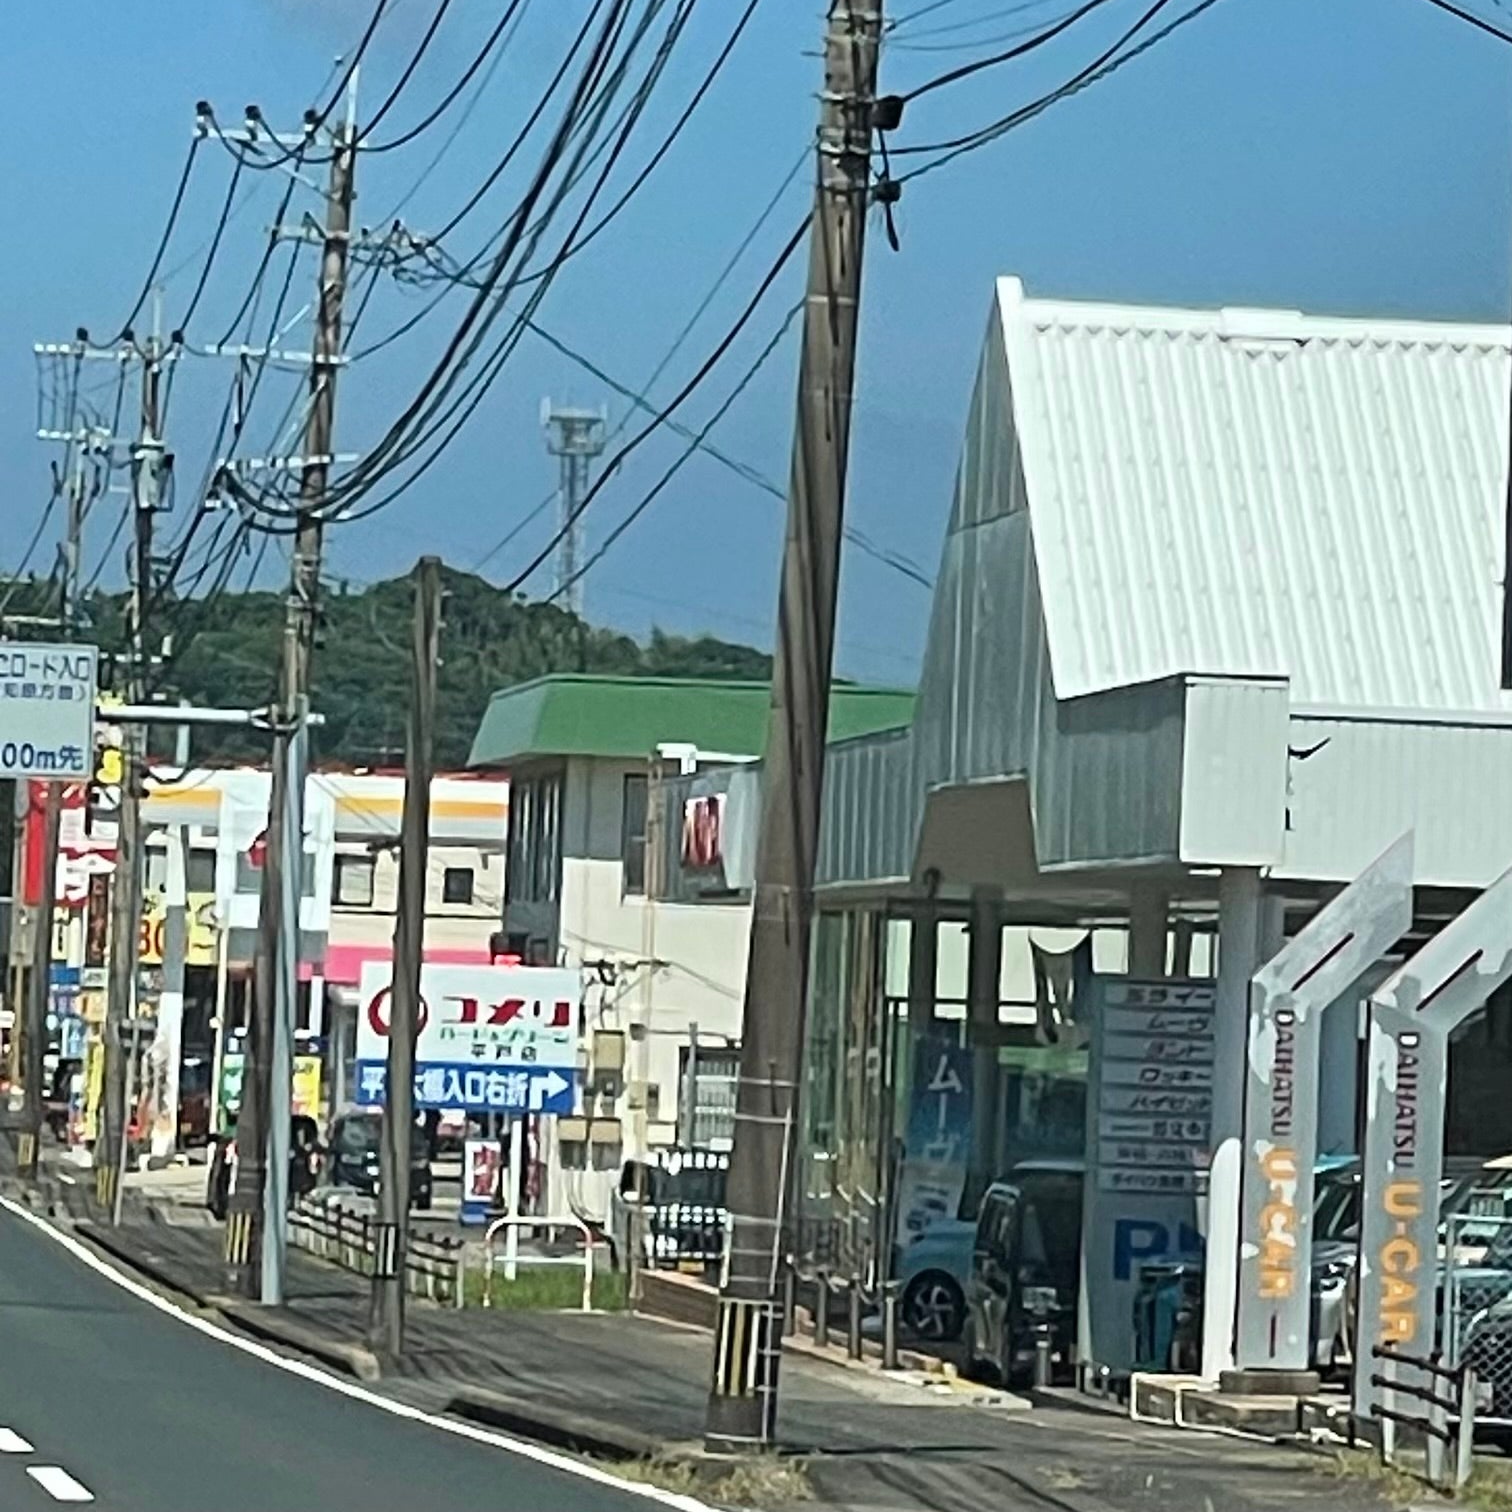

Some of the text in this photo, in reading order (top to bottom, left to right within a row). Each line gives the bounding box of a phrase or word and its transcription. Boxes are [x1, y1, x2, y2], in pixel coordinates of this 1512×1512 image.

[442, 996, 570, 1028] コメリ
[361, 1066, 529, 1108] 平橋入口右折
[1272, 1008, 1296, 1138] DAIHATSU
[1379, 1031, 1424, 1344] DAIHATSU U-CAR
[1113, 1218, 1169, 1282] P
